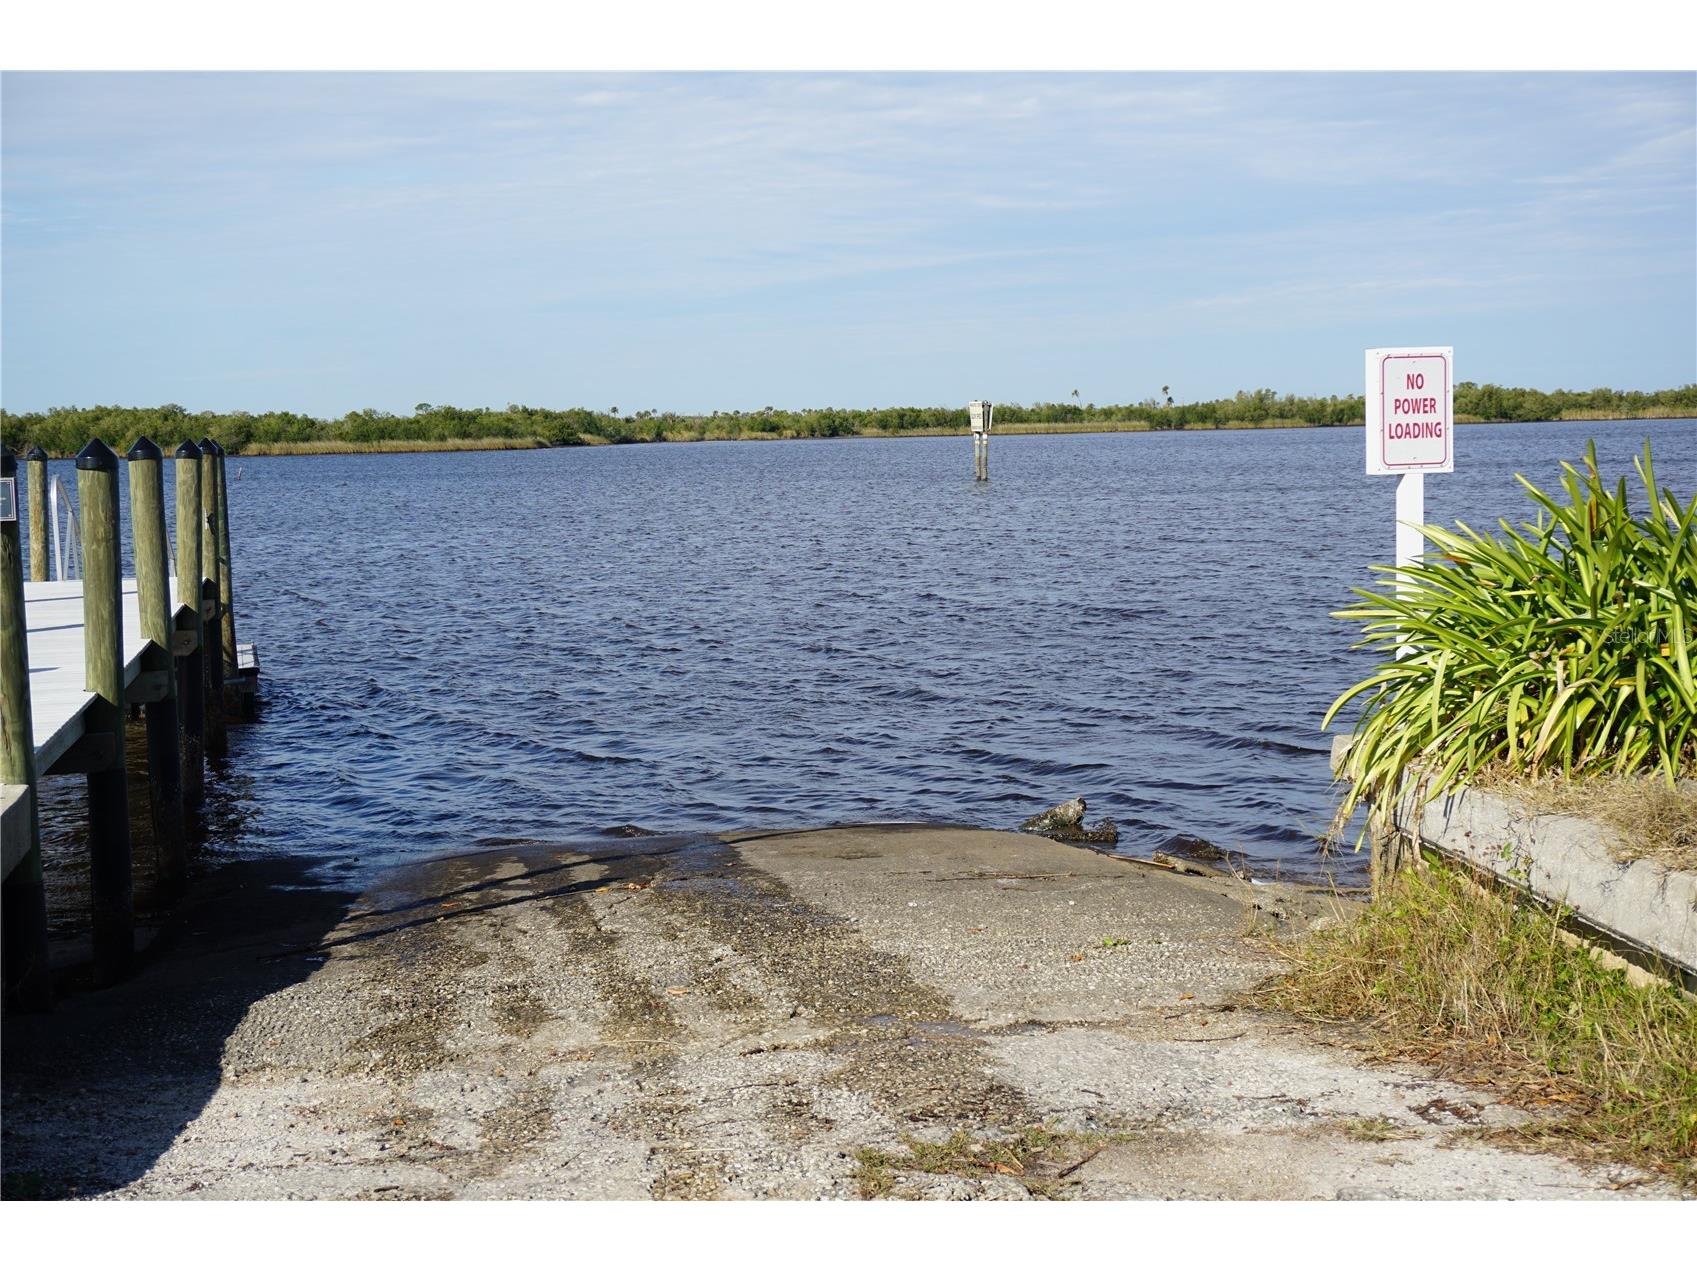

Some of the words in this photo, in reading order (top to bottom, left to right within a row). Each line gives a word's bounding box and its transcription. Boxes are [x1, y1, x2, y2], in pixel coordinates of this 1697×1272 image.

[1406, 373, 1424, 390] NO
[1394, 398, 1437, 415] POWER
[1388, 422, 1443, 440] LOADING
